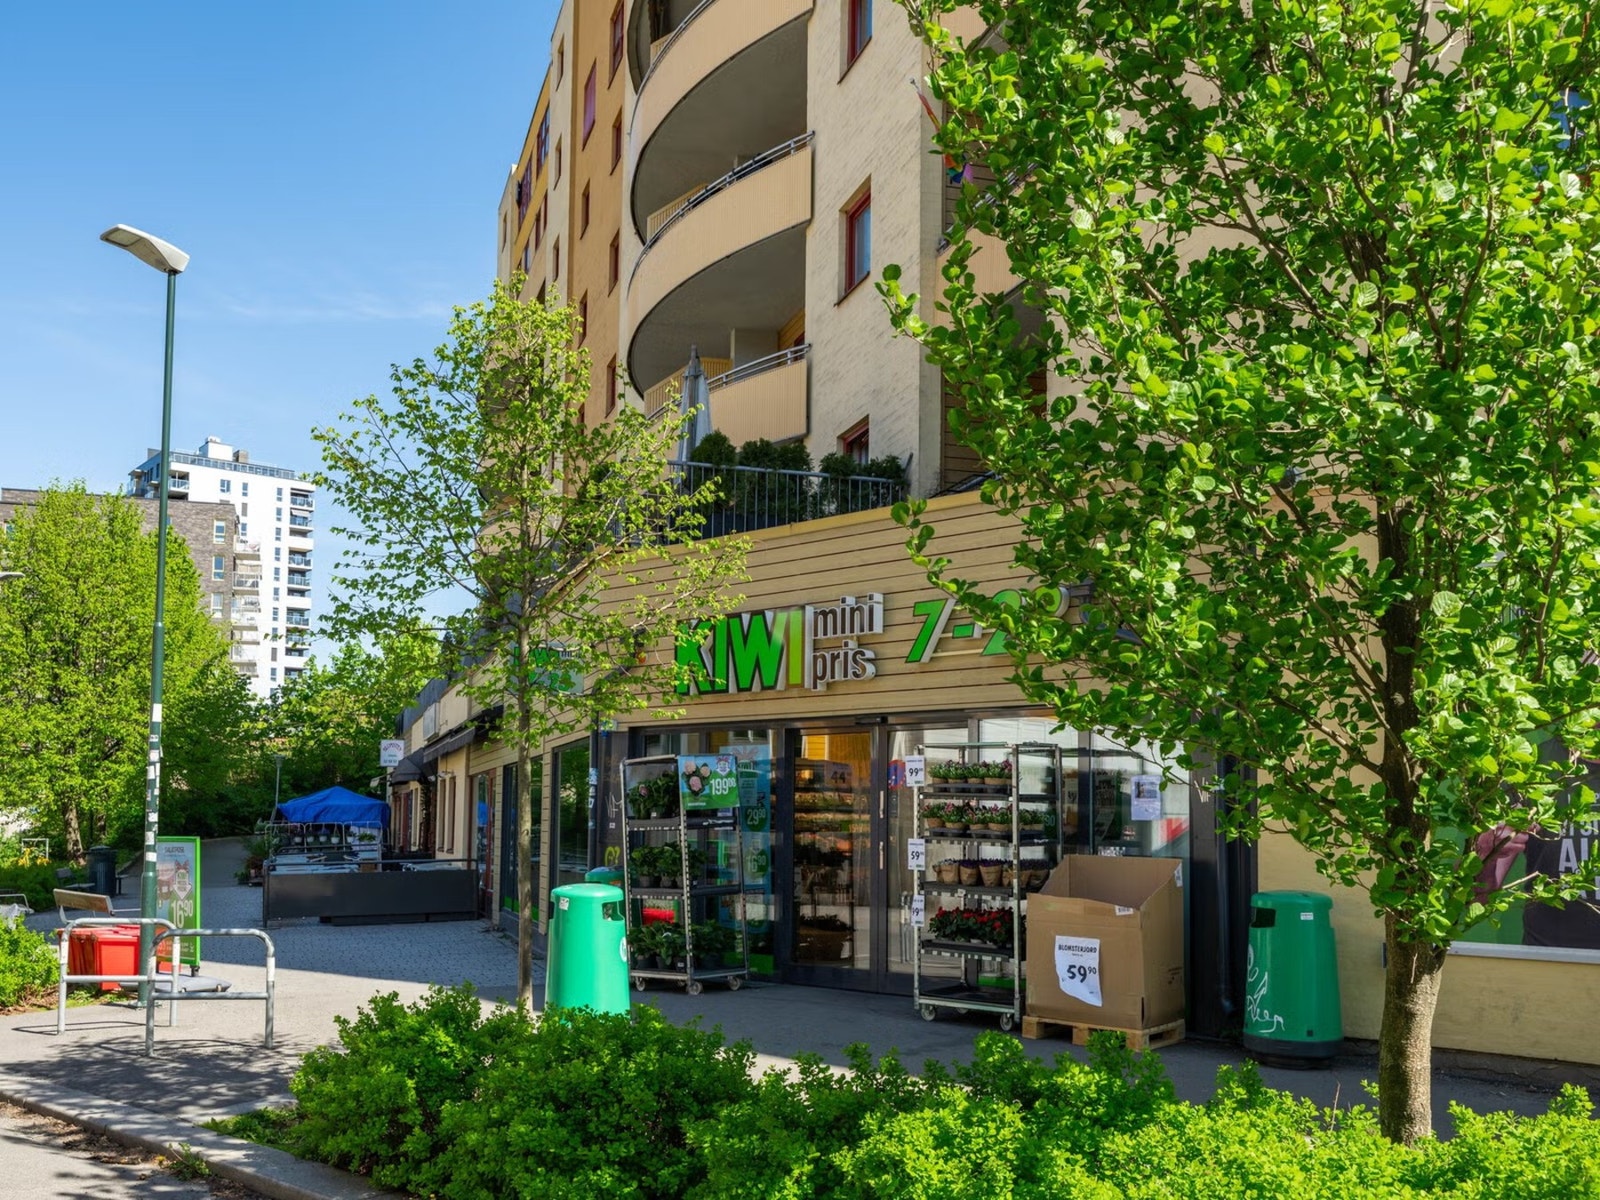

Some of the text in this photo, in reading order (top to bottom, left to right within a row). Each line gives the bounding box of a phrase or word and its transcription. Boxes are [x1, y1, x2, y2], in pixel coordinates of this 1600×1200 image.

[813, 593, 878, 638] mini
[676, 609, 804, 694] KIWI
[812, 640, 870, 691] pris
[171, 899, 194, 929] 1690
[1058, 944, 1098, 954] BLOMSTERJORD
[1067, 964, 1097, 983] 5990
